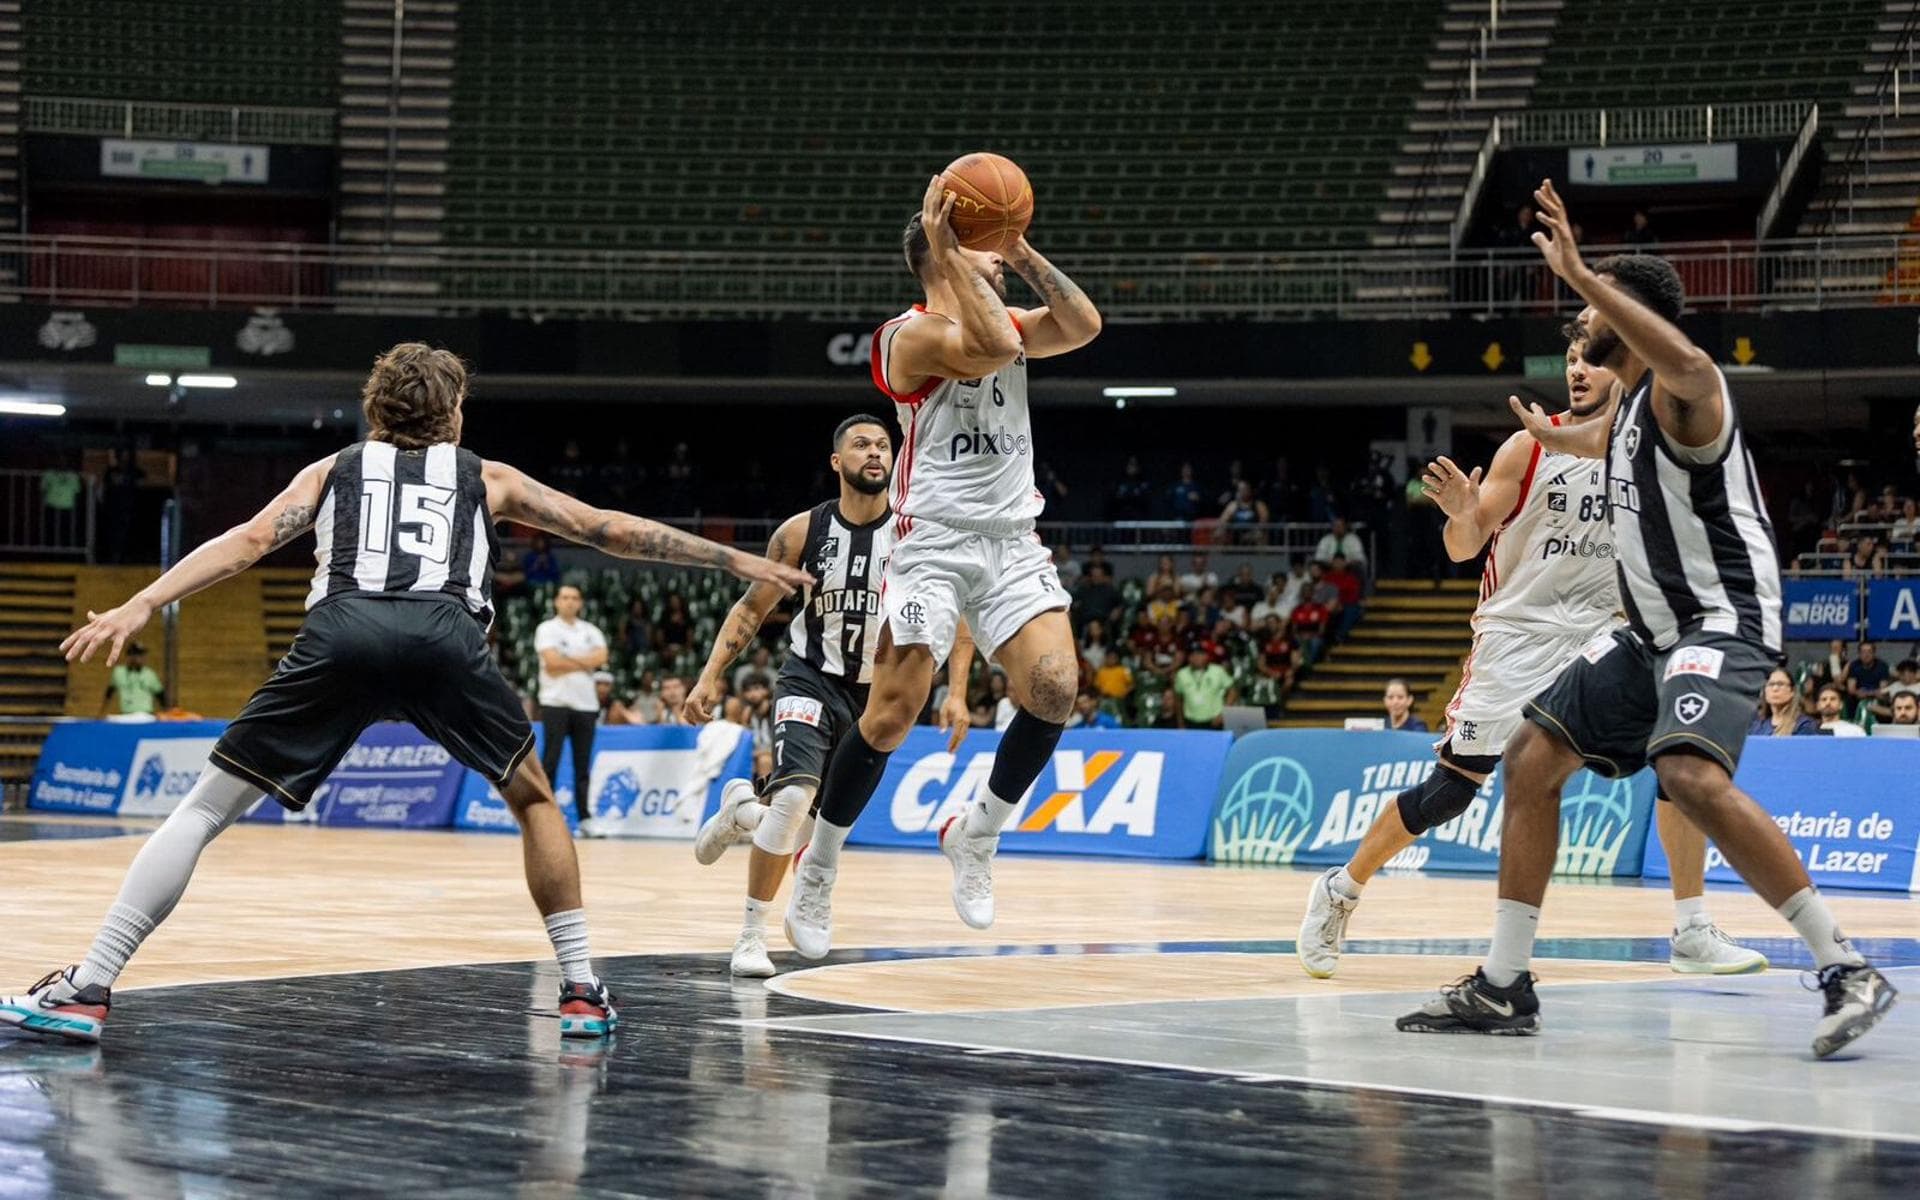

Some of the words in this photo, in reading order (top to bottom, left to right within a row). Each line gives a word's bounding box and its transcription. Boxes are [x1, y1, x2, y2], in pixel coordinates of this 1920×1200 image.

[993, 375, 1005, 407] 6
[361, 479, 456, 565] 15
[1579, 495, 1608, 522] 83
[815, 588, 879, 618] BOTAFO
[1809, 602, 1850, 625] BRB
[846, 623, 862, 653] 7
[775, 739, 785, 767] 7
[1857, 812, 1893, 840] de
[1808, 844, 1889, 874] Lazer
